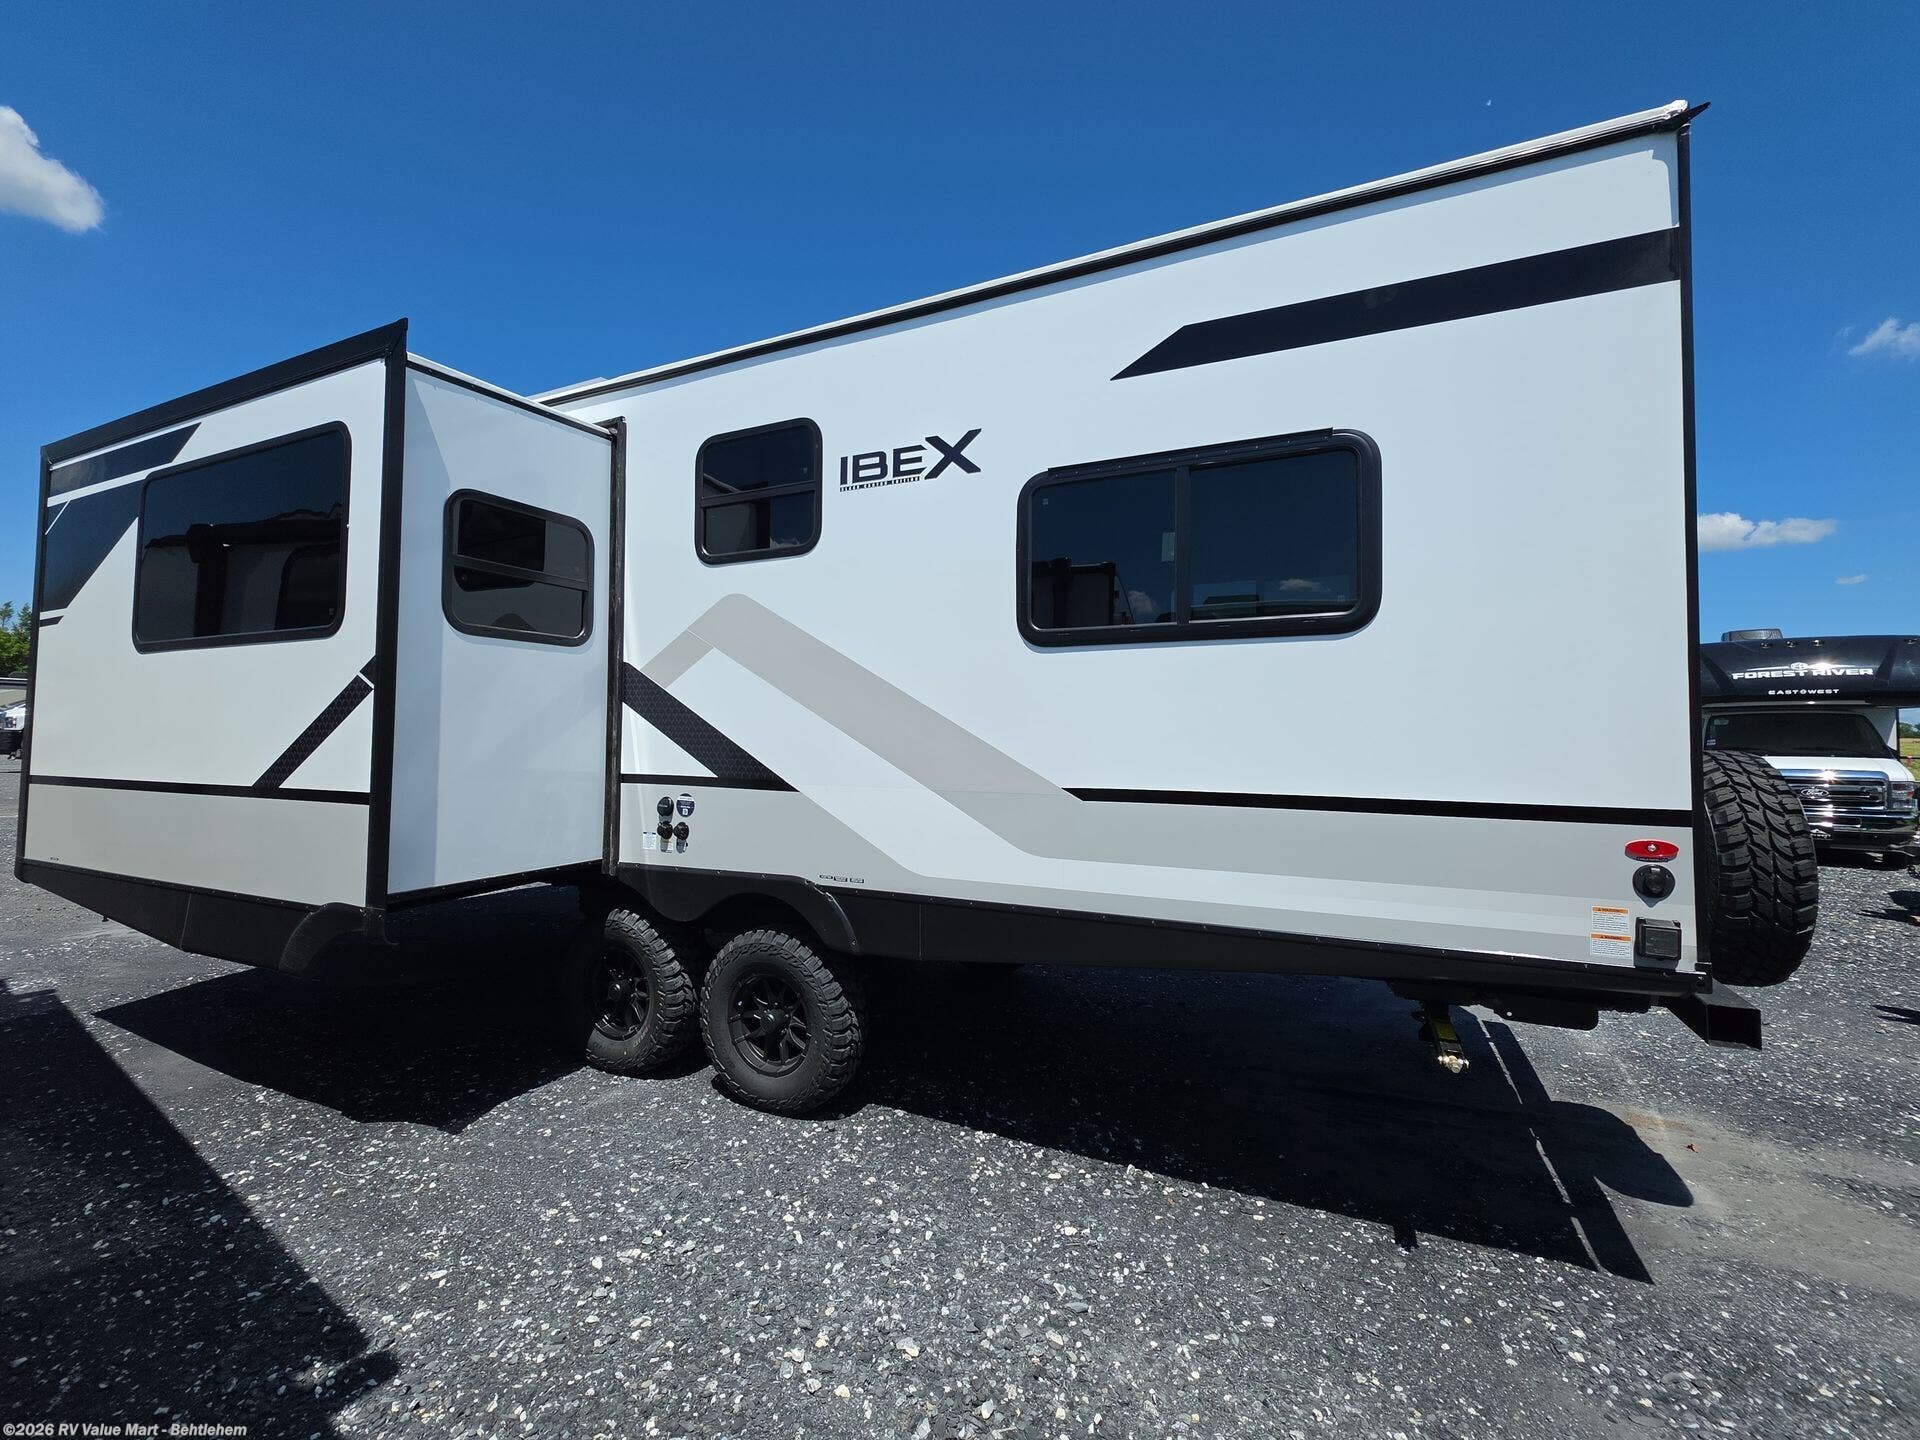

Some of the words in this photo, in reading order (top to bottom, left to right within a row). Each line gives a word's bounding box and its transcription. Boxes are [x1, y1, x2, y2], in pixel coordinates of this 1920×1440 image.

[840, 428, 982, 486] IBEX
[1731, 669, 1809, 680] FOREST
[1812, 668, 1874, 676] RIVER
